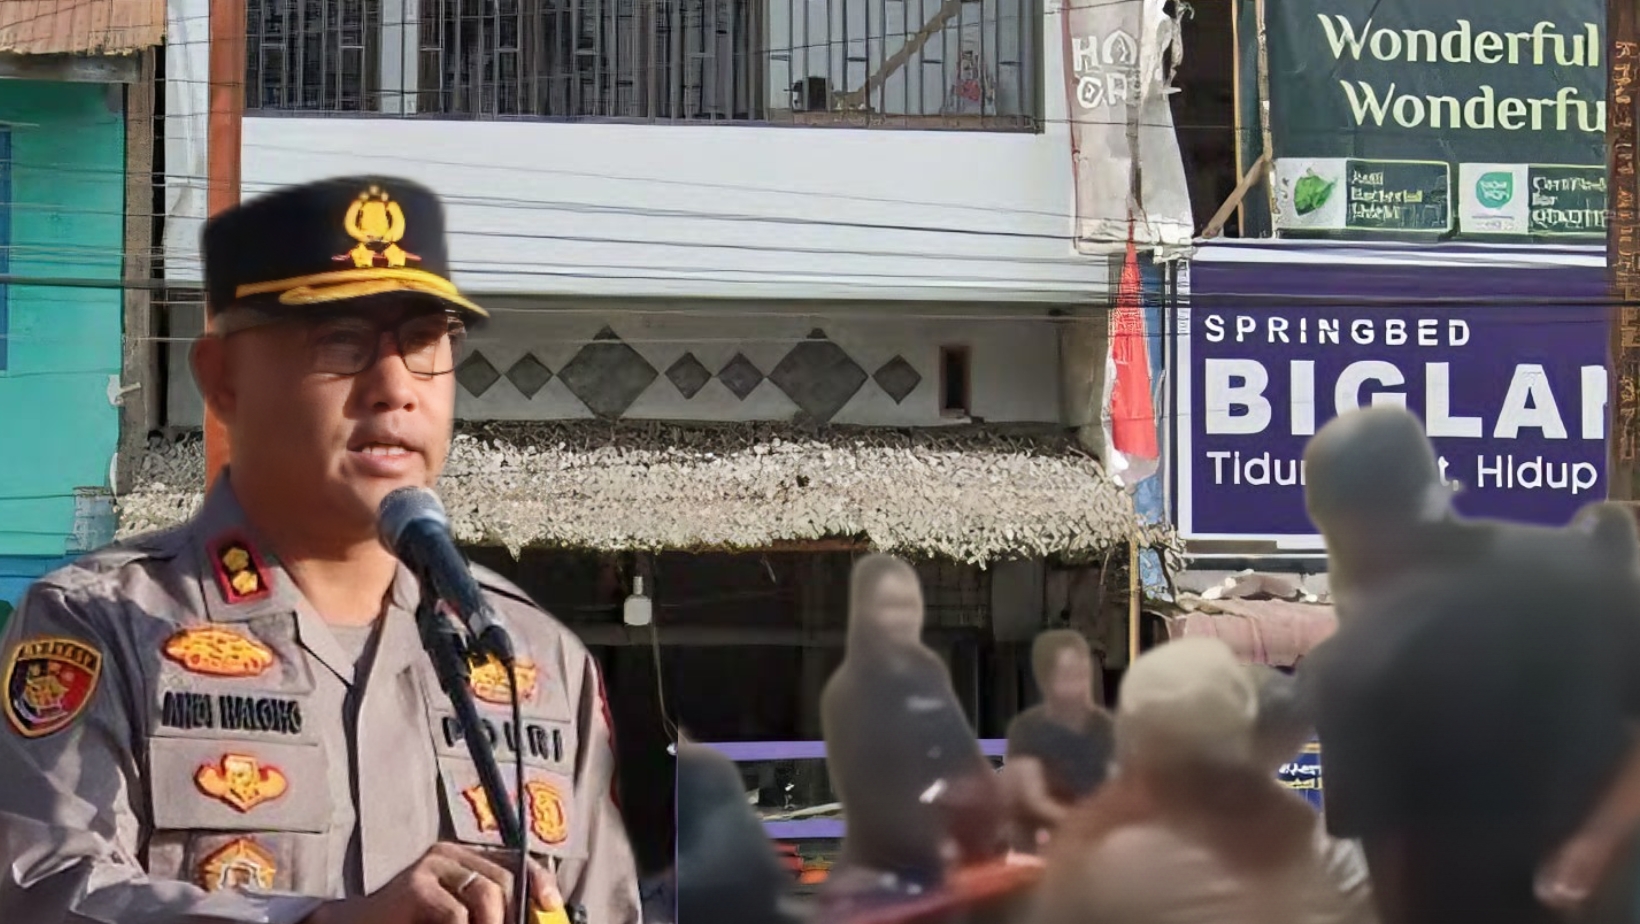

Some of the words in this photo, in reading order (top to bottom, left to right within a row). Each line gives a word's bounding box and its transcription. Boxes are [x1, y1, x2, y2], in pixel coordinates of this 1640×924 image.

[1317, 13, 1599, 67] Wonderful
[1204, 314, 1471, 347] SPRINGBED
[1477, 454, 1598, 495] Hidup
